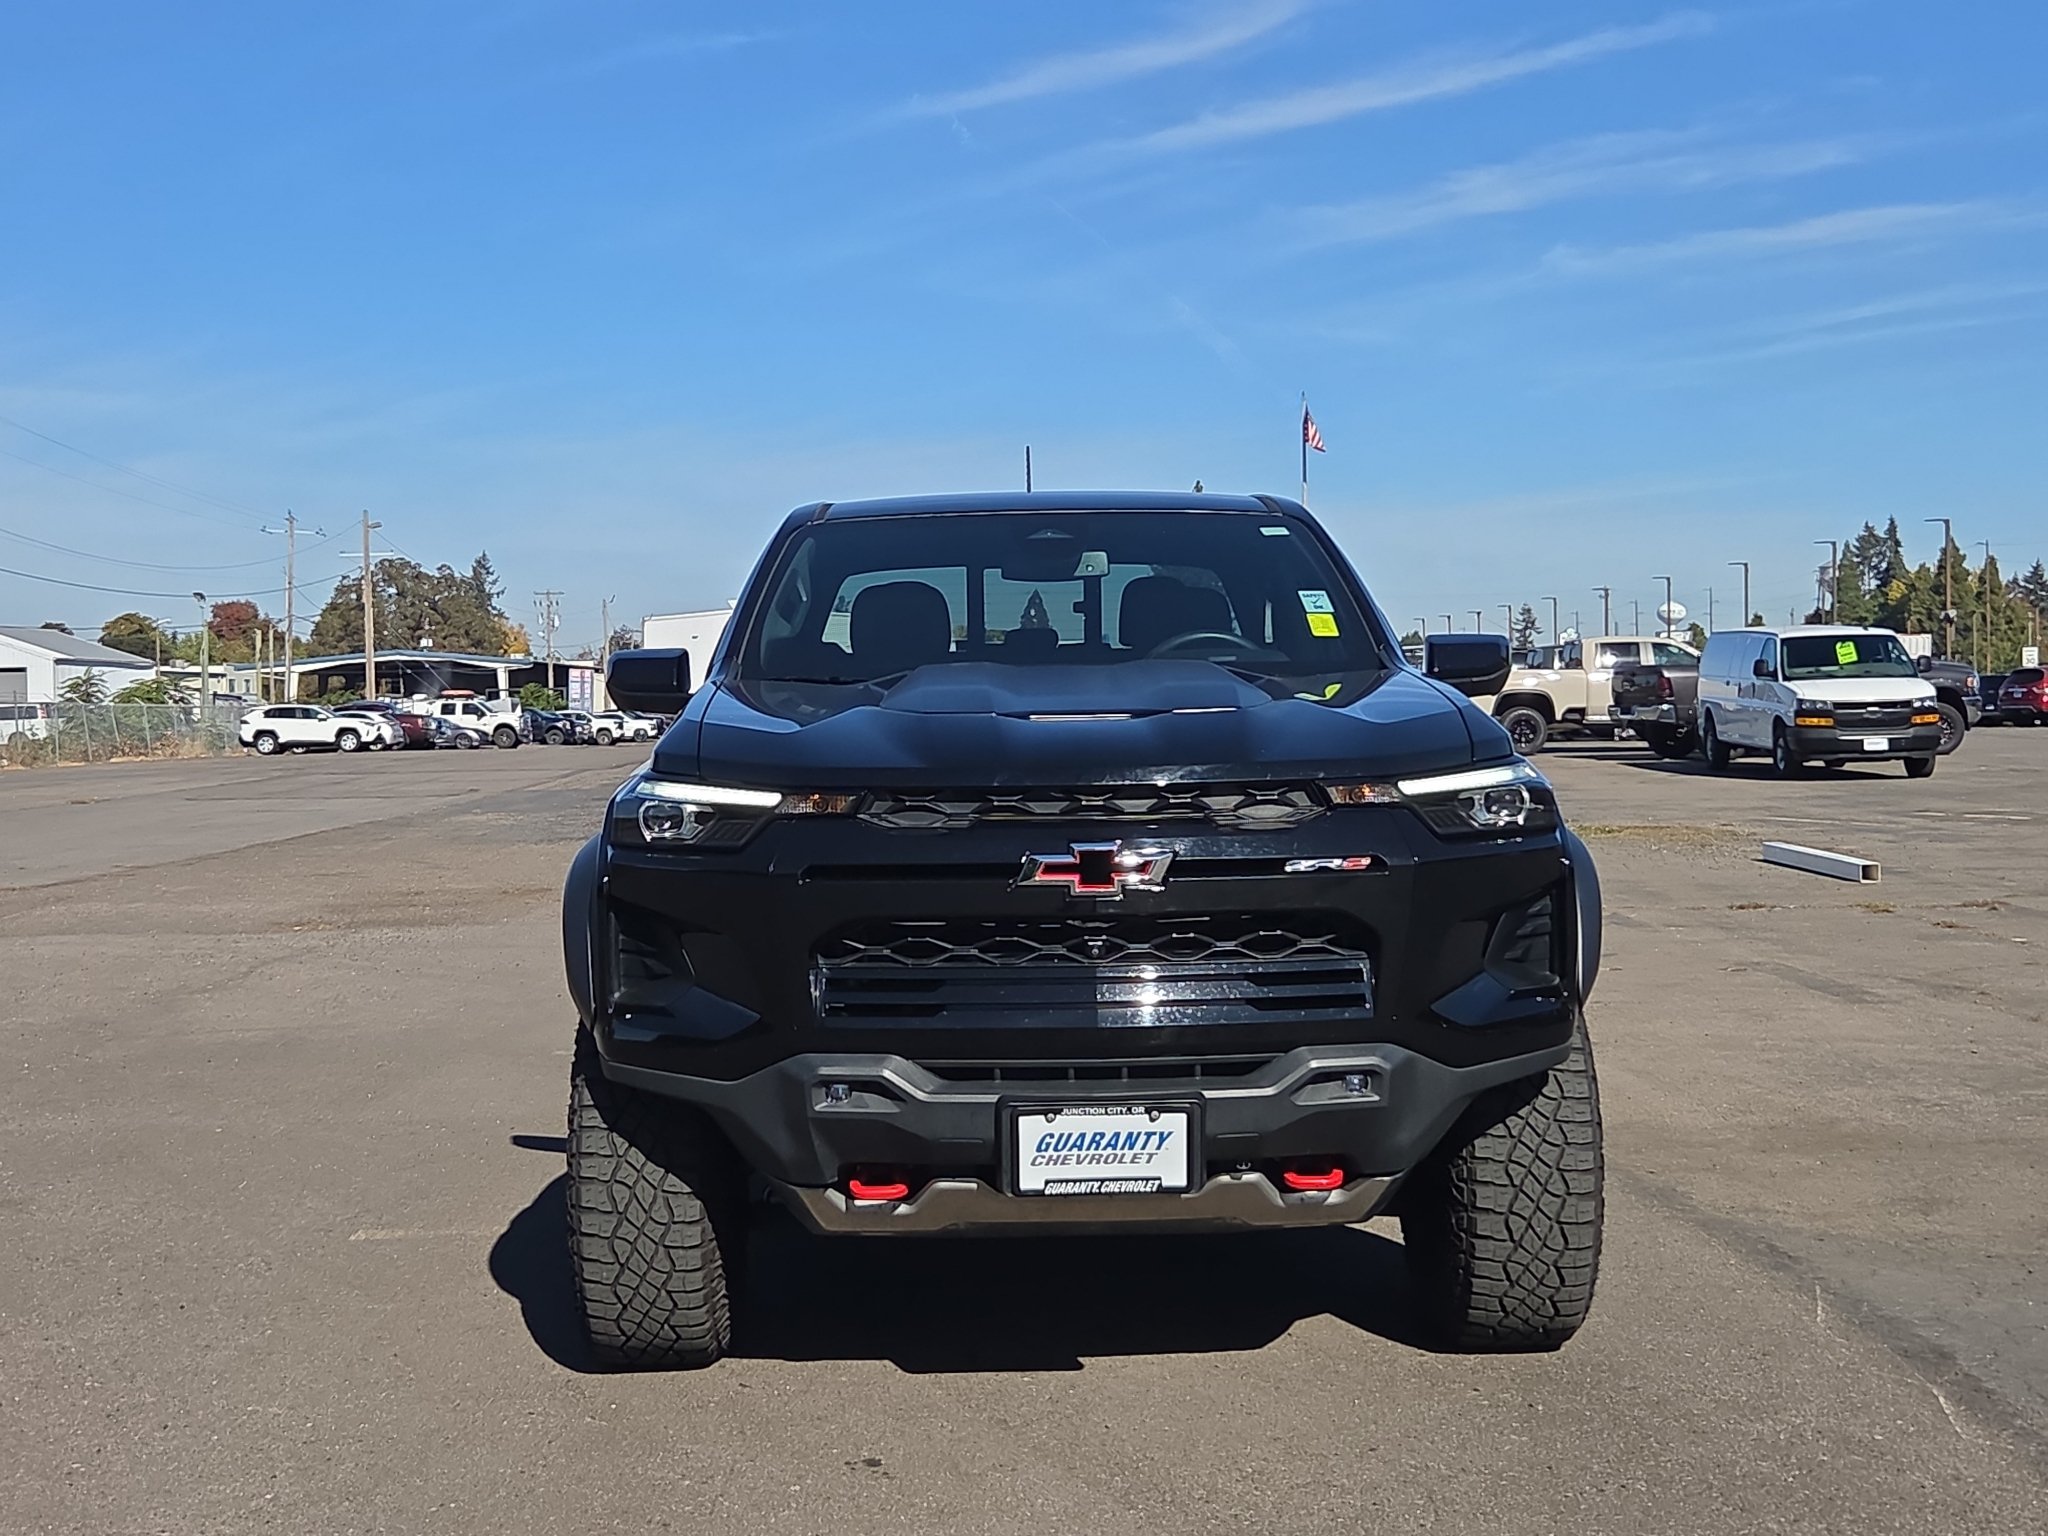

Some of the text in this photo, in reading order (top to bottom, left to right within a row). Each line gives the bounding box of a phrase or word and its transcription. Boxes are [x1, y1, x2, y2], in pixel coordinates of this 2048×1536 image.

[1061, 1107, 1106, 1115] JUNCTION
[1131, 1106, 1146, 1114] OR
[1035, 1131, 1174, 1153] GUARANTY
[1030, 1152, 1158, 1167] CHEVROLET
[1100, 1180, 1161, 1193] CHEVROLET
